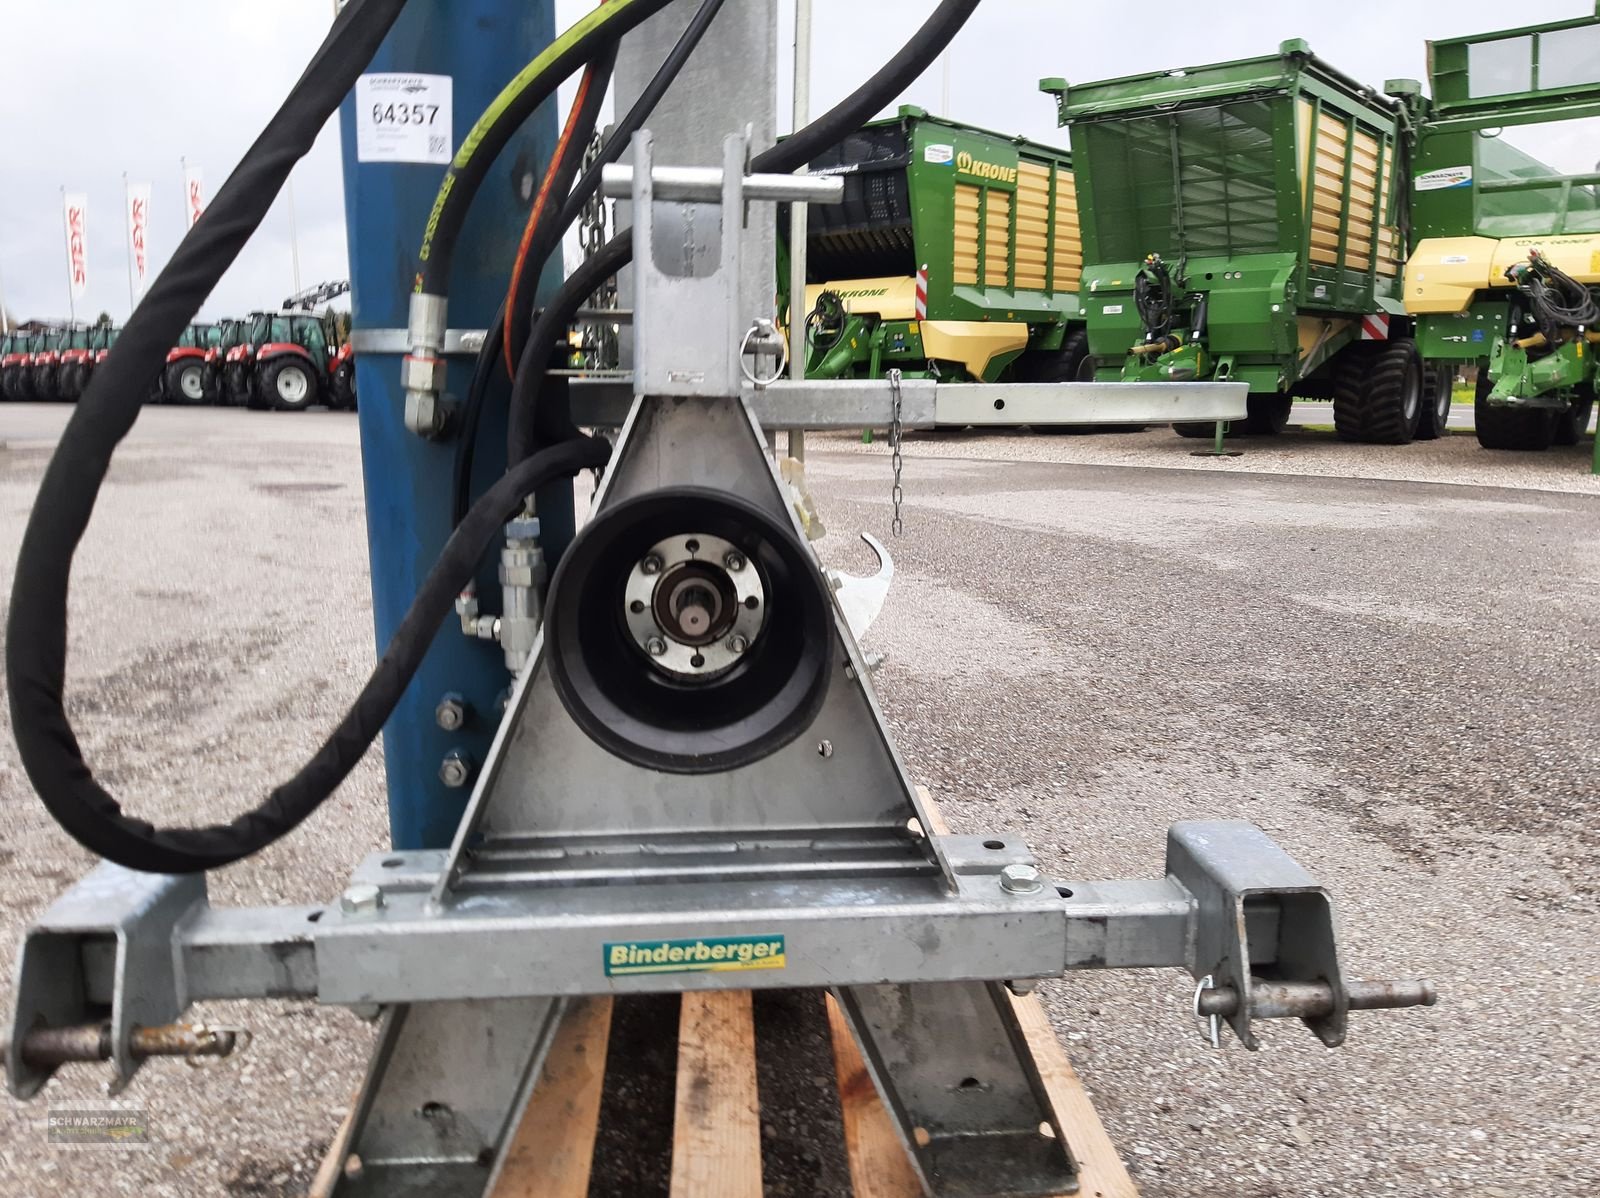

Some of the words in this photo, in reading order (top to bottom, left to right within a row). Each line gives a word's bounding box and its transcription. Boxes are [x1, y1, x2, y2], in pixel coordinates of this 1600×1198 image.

[372, 102, 439, 125] 64357
[971, 160, 1017, 183] KRONE
[839, 288, 889, 299] KRONE
[609, 941, 782, 965] Binderberger
